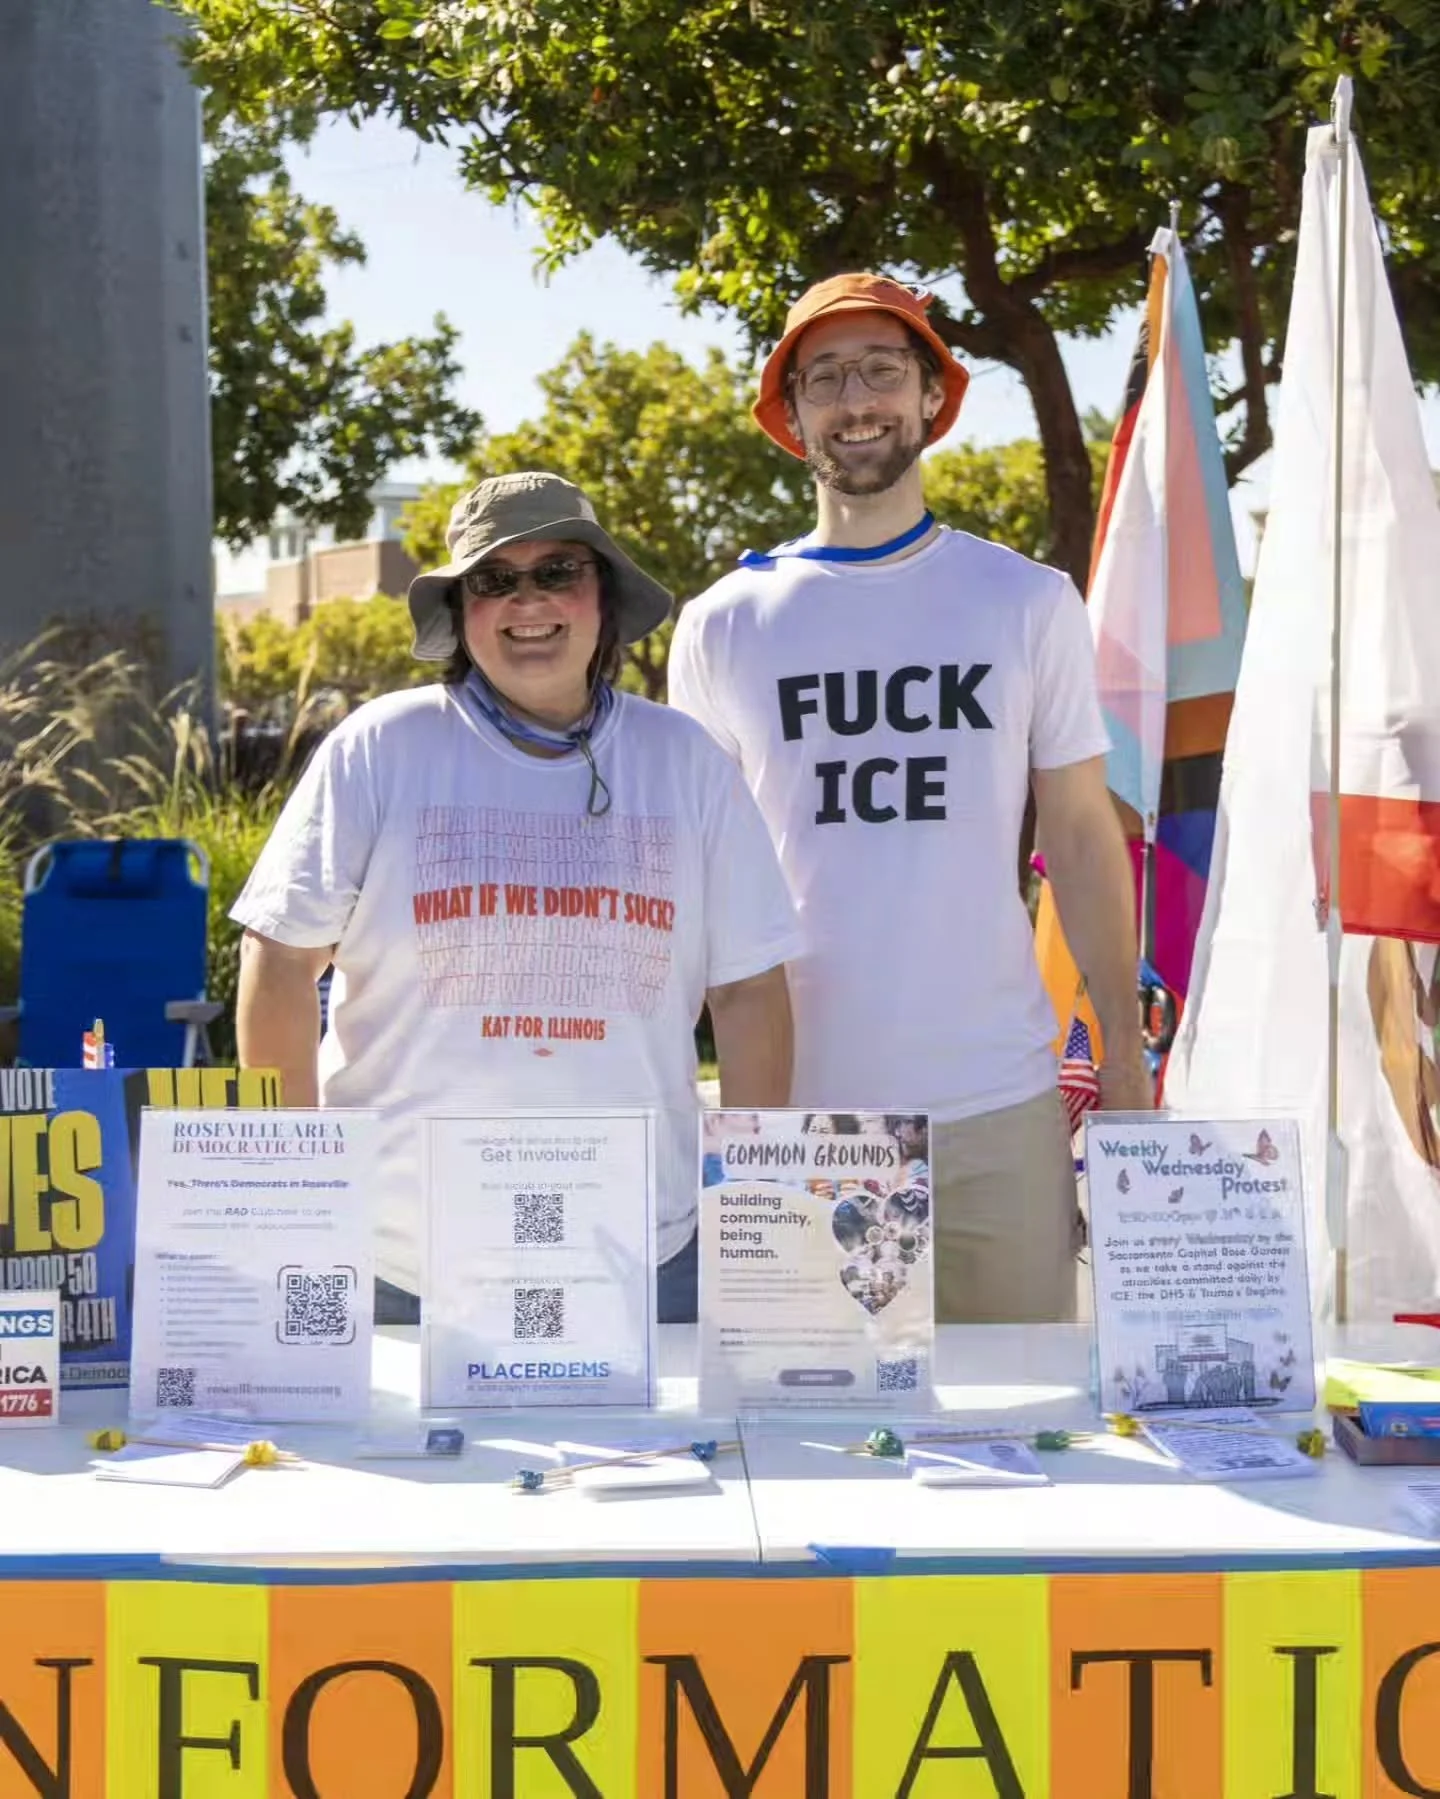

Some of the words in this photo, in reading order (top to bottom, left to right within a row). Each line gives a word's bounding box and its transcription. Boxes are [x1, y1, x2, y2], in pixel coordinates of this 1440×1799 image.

[777, 664, 994, 741] FUCK
[815, 756, 947, 825] ICE
[412, 885, 473, 925] WHAT
[479, 883, 498, 916] IF
[505, 883, 537, 916] WE
[544, 885, 620, 920] DIDN'T
[624, 893, 675, 931] SUCK?
[482, 1016, 511, 1037] KAT
[515, 1016, 543, 1038] FOR
[548, 1017, 606, 1040] ILLINOIS
[0, 1068, 57, 1111] VOTE
[174, 1122, 283, 1138] ROSEVILLE
[292, 1122, 344, 1138] AREA
[173, 1140, 292, 1154] DEMOCRATIC
[298, 1140, 345, 1155] CLUB
[480, 1147, 512, 1162] Get
[726, 1143, 806, 1167] COMMON
[814, 1143, 896, 1168] GROUNDS
[1098, 1139, 1168, 1164] Weekly
[1142, 1159, 1245, 1178] Wednesday
[0, 1111, 104, 1251] ES
[231, 1179, 288, 1188] Democrats
[1222, 1176, 1288, 1200] Protest
[720, 1194, 782, 1210] building
[720, 1212, 812, 1227] community,
[720, 1228, 763, 1244] being
[1104, 1236, 1129, 1248] Join
[720, 1246, 779, 1259] human.
[68, 1252, 97, 1295] 50
[1155, 1263, 1177, 1273] take
[1193, 1261, 1222, 1272] stand
[1227, 1261, 1264, 1272] against
[1269, 1260, 1286, 1270] the
[1175, 1274, 1233, 1286] committed
[1160, 1288, 1184, 1300] DHS
[0, 1314, 51, 1334] NGS
[0, 1366, 47, 1384] ICA
[468, 1362, 611, 1379] PLACERDEMS
[0, 1643, 1440, 1799] NFORMATI
